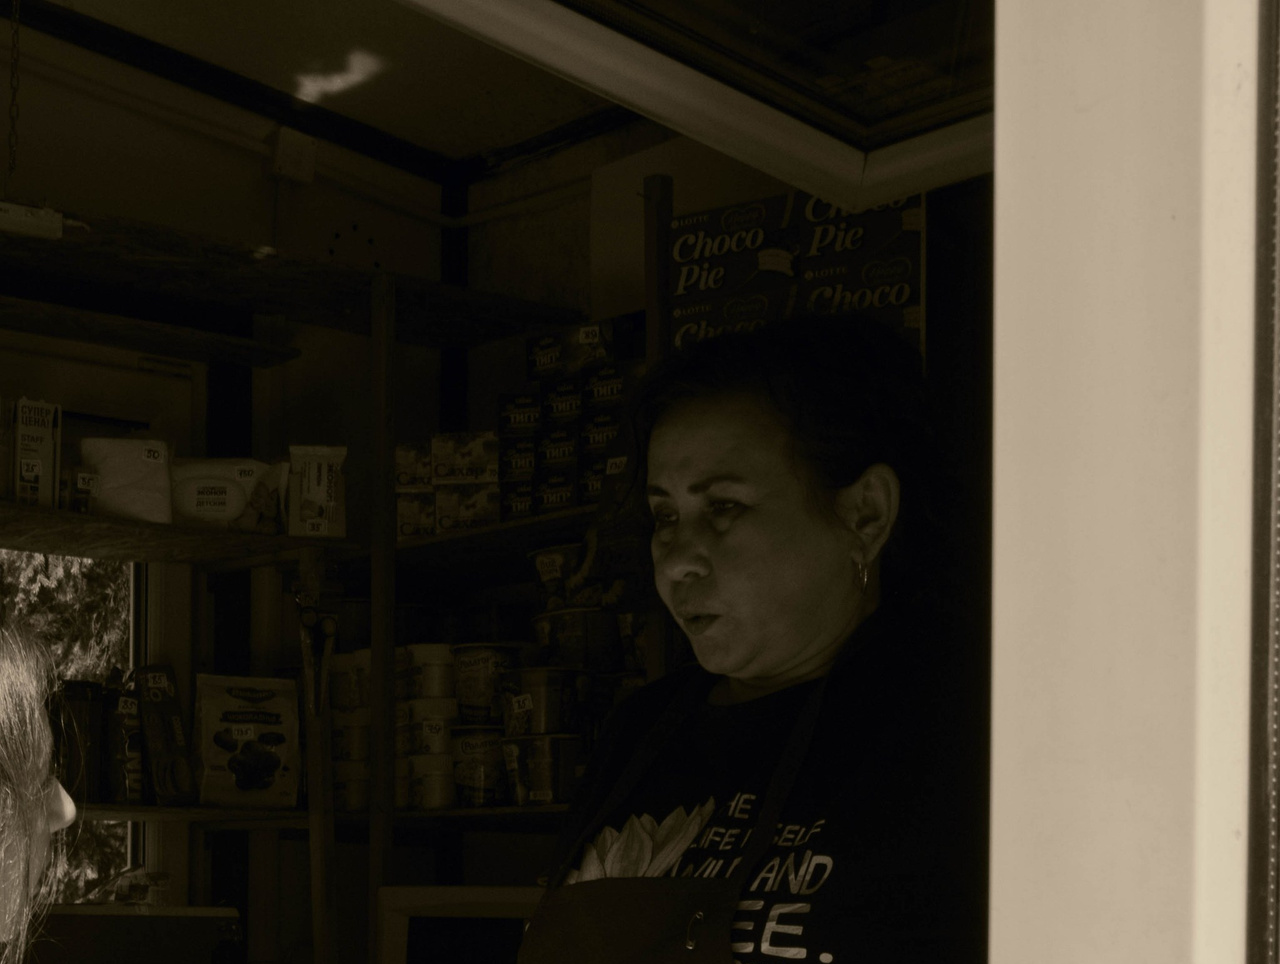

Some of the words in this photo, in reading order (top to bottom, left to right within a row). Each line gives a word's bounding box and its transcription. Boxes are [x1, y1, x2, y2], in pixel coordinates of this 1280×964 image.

[672, 228, 765, 263] Choco
[805, 222, 865, 258] Pie
[673, 262, 725, 296] Pie
[21, 404, 51, 418] СУПЕР
[749, 850, 834, 895] AND
